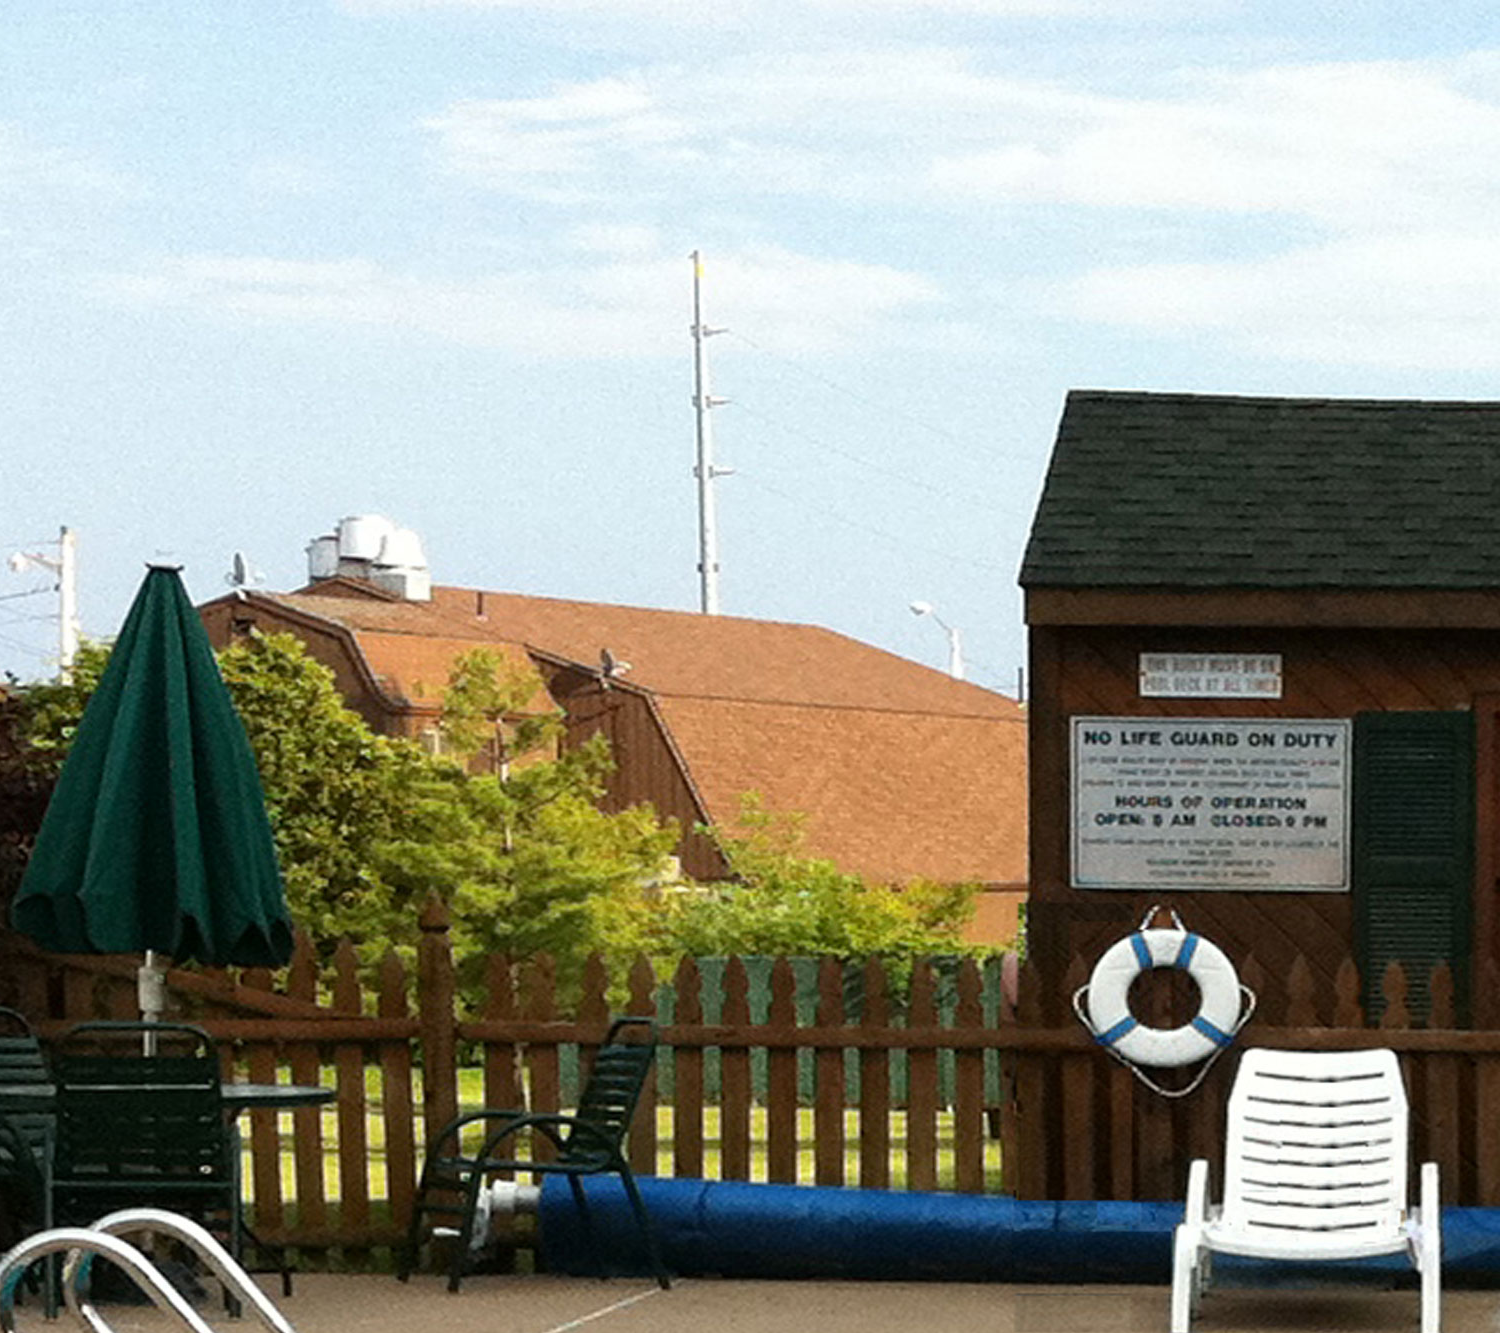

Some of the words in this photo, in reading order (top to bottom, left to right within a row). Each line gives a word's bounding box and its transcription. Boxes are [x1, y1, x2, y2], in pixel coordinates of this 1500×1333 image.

[1083, 731, 1112, 746] NO
[1121, 731, 1162, 746] LIFE
[1170, 731, 1239, 747] GUARD
[1248, 732, 1275, 747] ON
[1283, 732, 1337, 748] DUTY
[1115, 795, 1173, 808] HOURS
[1181, 796, 1203, 808] OF
[1210, 796, 1307, 810] OPERATION
[1170, 814, 1196, 826] AM
[1302, 815, 1328, 828] PM
